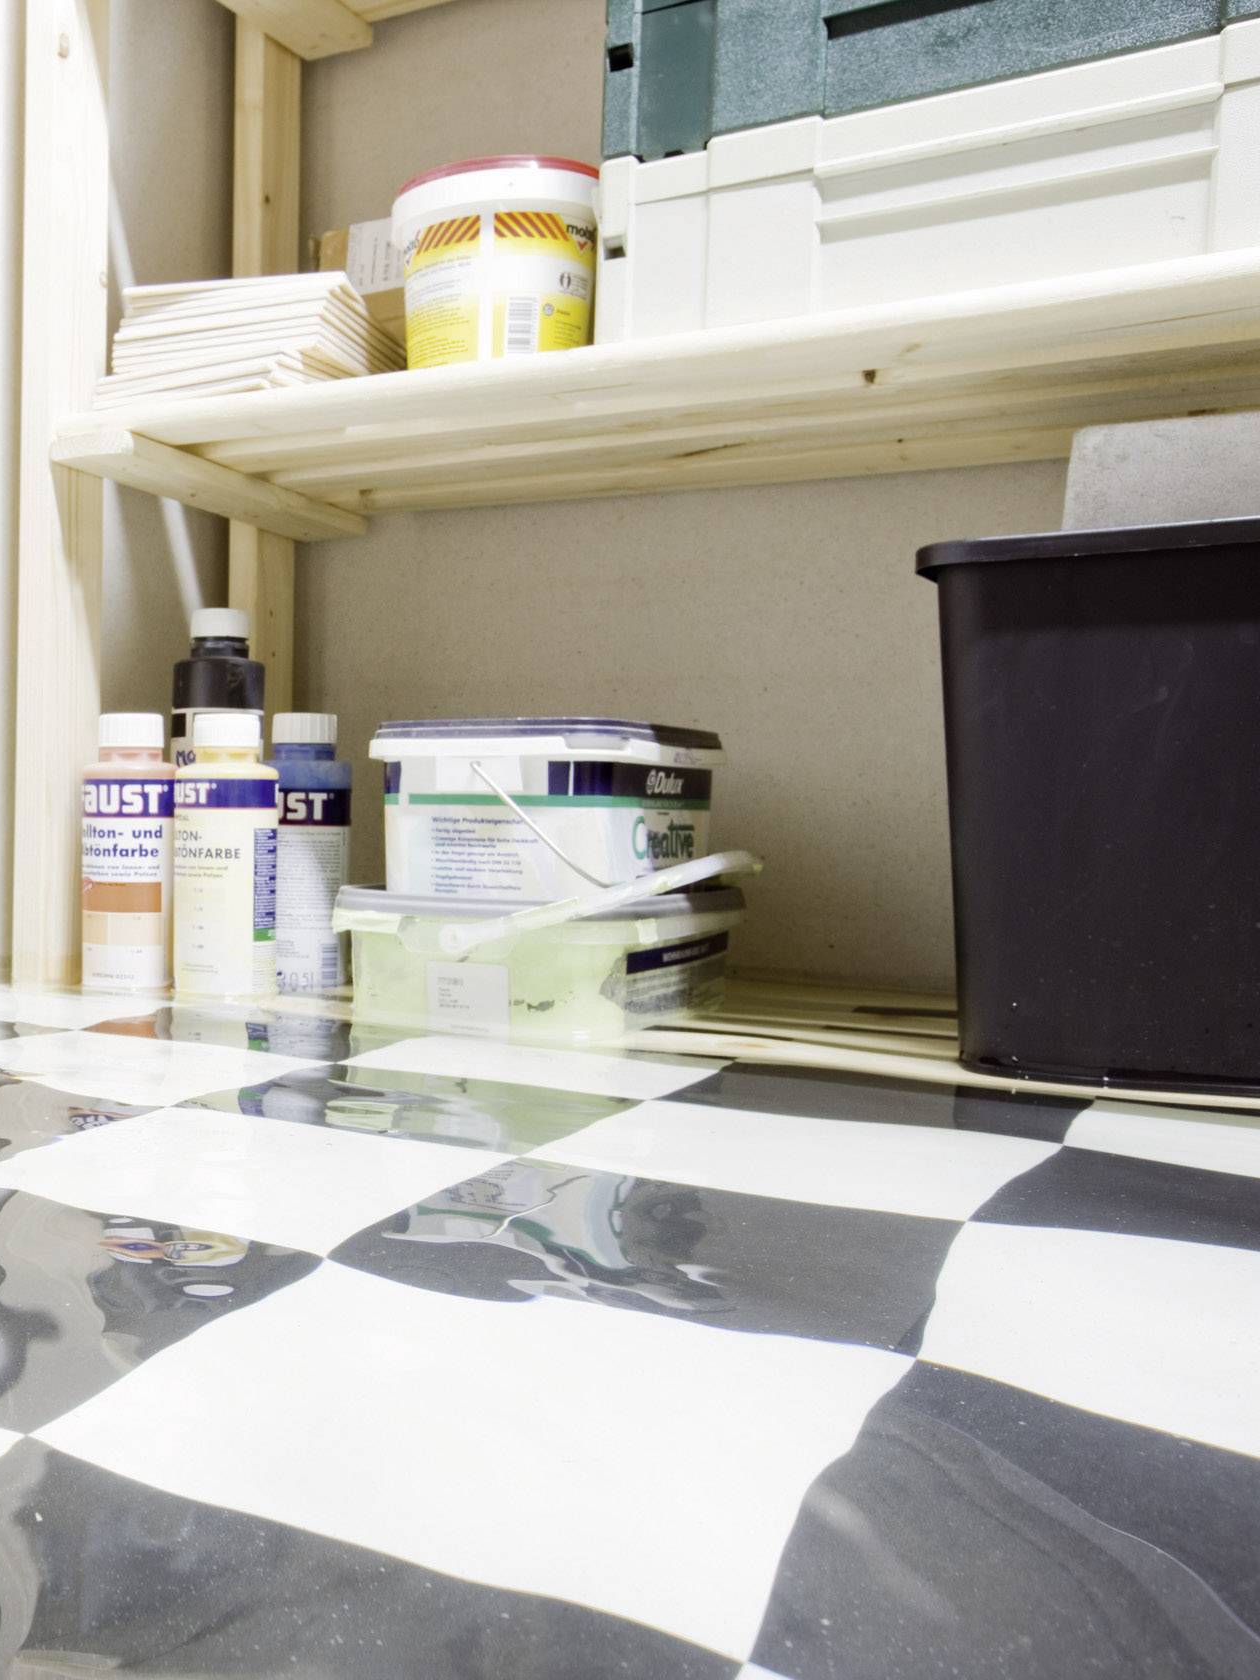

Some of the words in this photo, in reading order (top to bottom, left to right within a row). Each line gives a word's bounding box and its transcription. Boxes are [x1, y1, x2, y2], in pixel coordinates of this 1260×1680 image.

[174, 783, 210, 804] UST
[655, 771, 684, 794] Dulux
[81, 784, 163, 814] aUST
[132, 825, 163, 839] und
[632, 816, 694, 859] Creative
